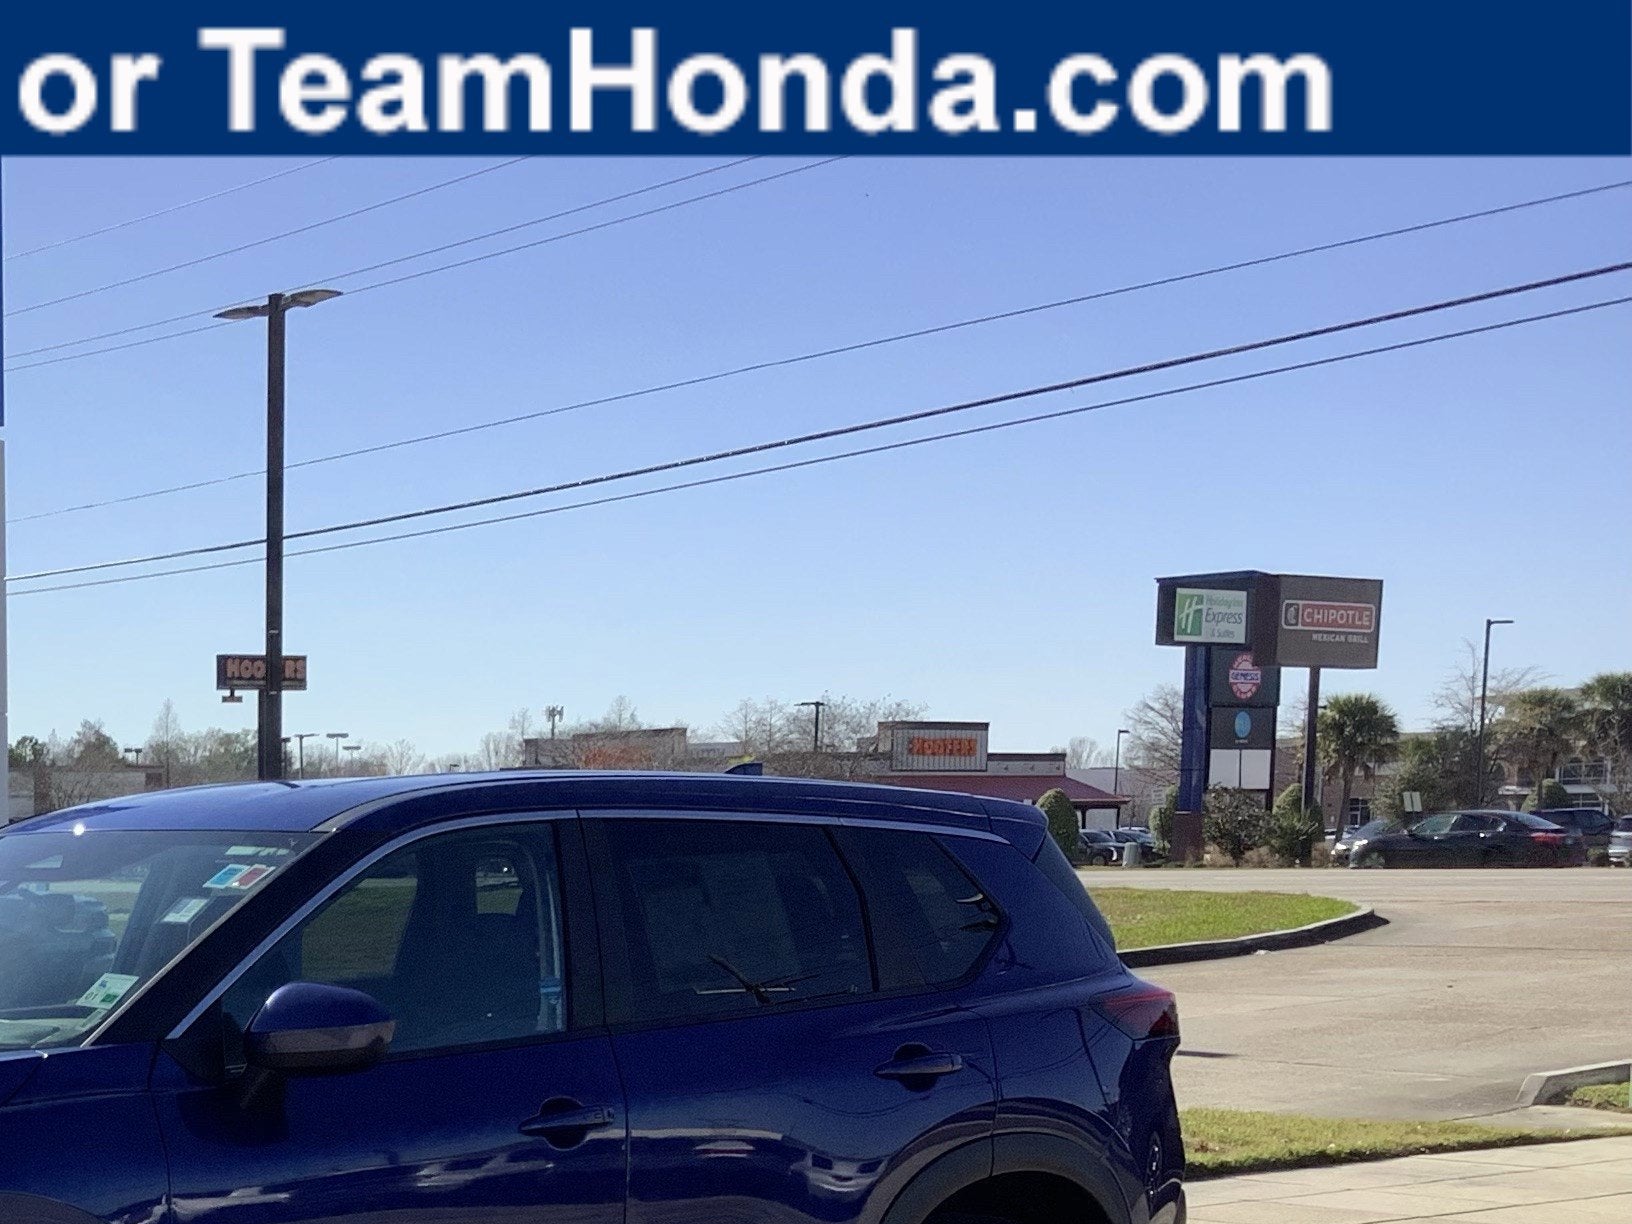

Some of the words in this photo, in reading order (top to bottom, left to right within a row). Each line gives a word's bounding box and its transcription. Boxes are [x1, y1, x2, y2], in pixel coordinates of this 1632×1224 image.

[1204, 608, 1244, 627] Express
[1303, 607, 1371, 626] CHIPOTLE
[1311, 633, 1346, 643] MEXICAN
[226, 657, 305, 679] HOORS
